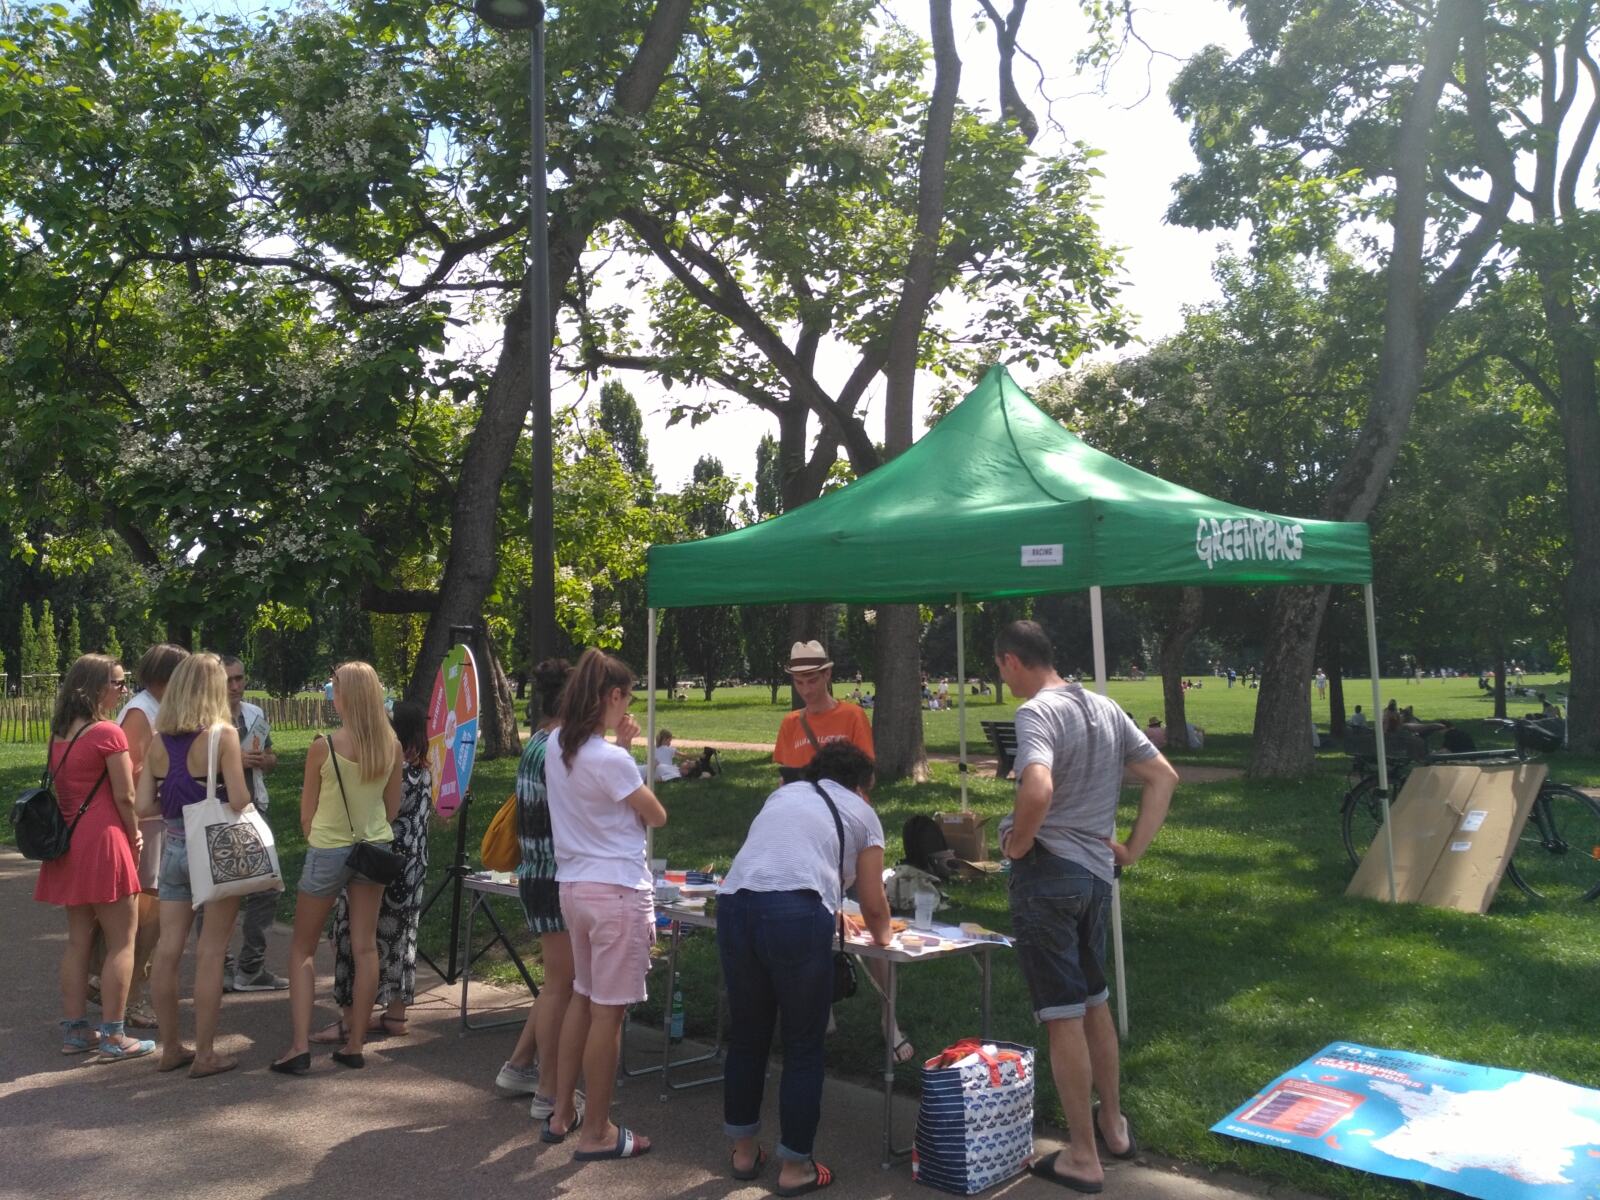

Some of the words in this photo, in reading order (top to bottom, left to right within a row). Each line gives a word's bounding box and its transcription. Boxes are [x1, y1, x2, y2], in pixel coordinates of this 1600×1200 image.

[1196, 518, 1304, 569] GREENPEACE
[1336, 1045, 1362, 1054] 70
[1358, 1063, 1408, 1079] VIANDE
[1375, 1072, 1423, 1088] JOURS
